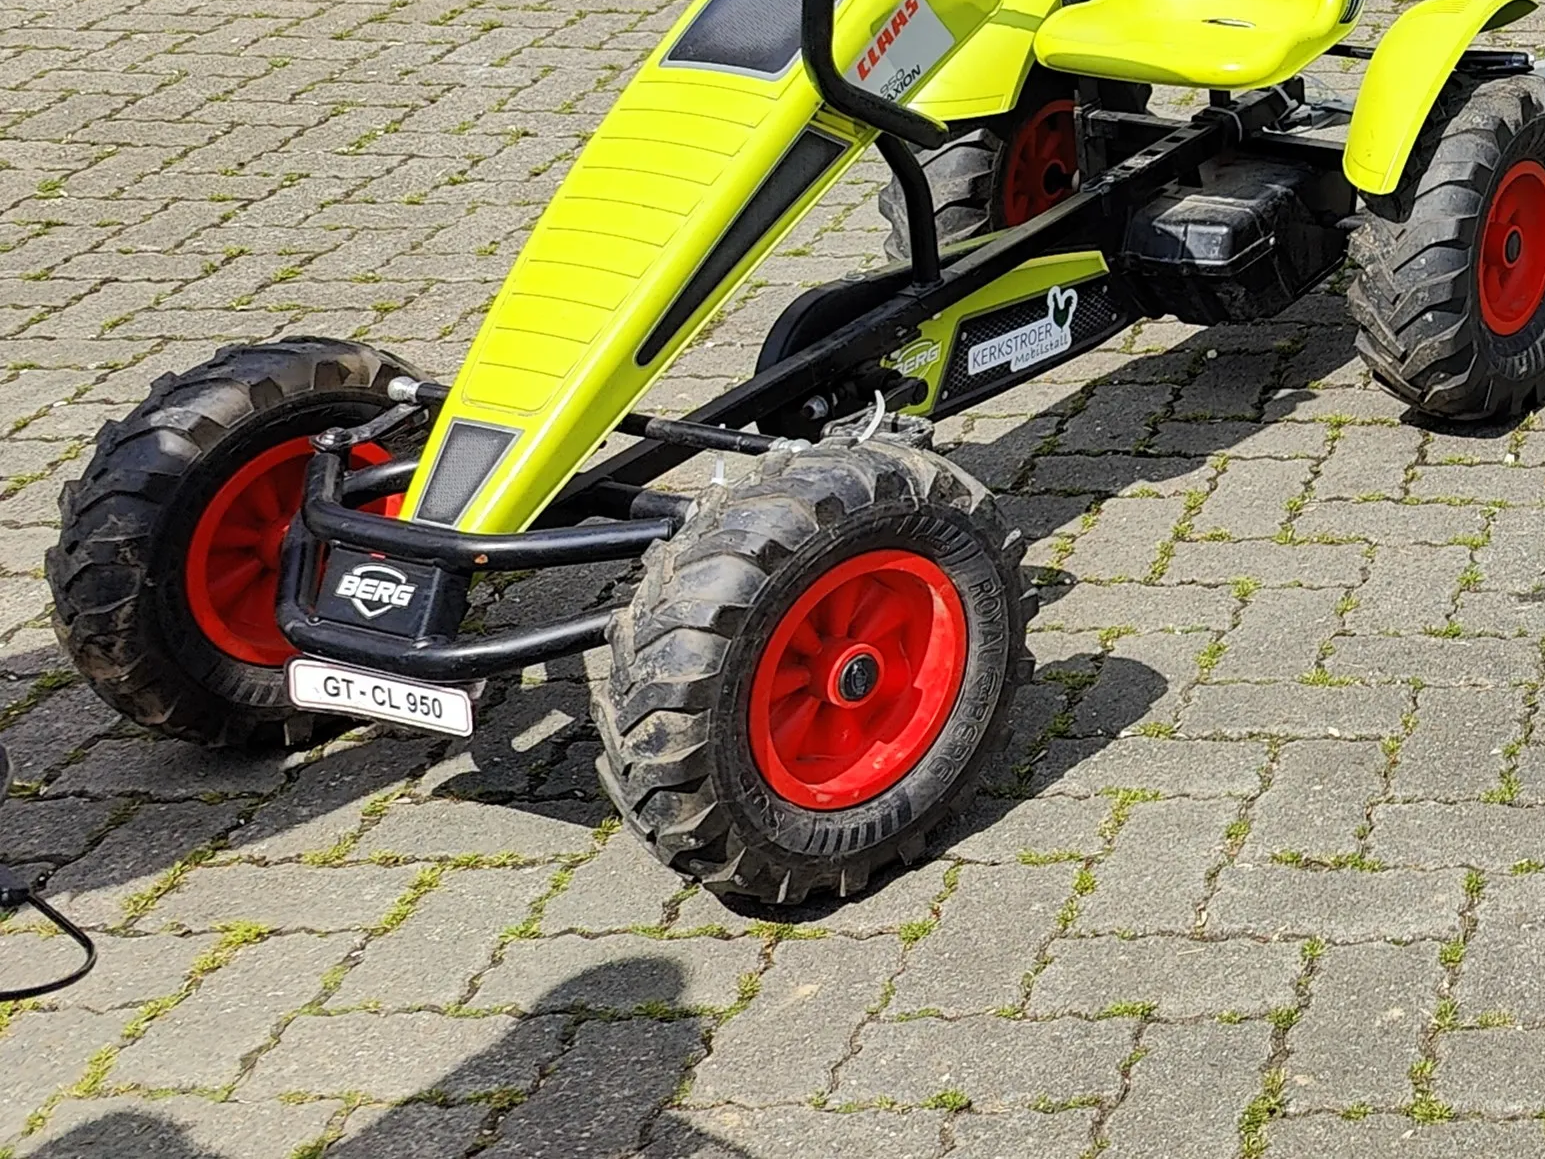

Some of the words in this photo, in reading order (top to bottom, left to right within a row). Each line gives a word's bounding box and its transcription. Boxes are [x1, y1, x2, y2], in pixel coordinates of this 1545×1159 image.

[972, 322, 1054, 370] KERKSTROER
[1014, 334, 1069, 367] Mobilstall
[335, 574, 417, 607] BERG
[405, 691, 443, 720] 950
